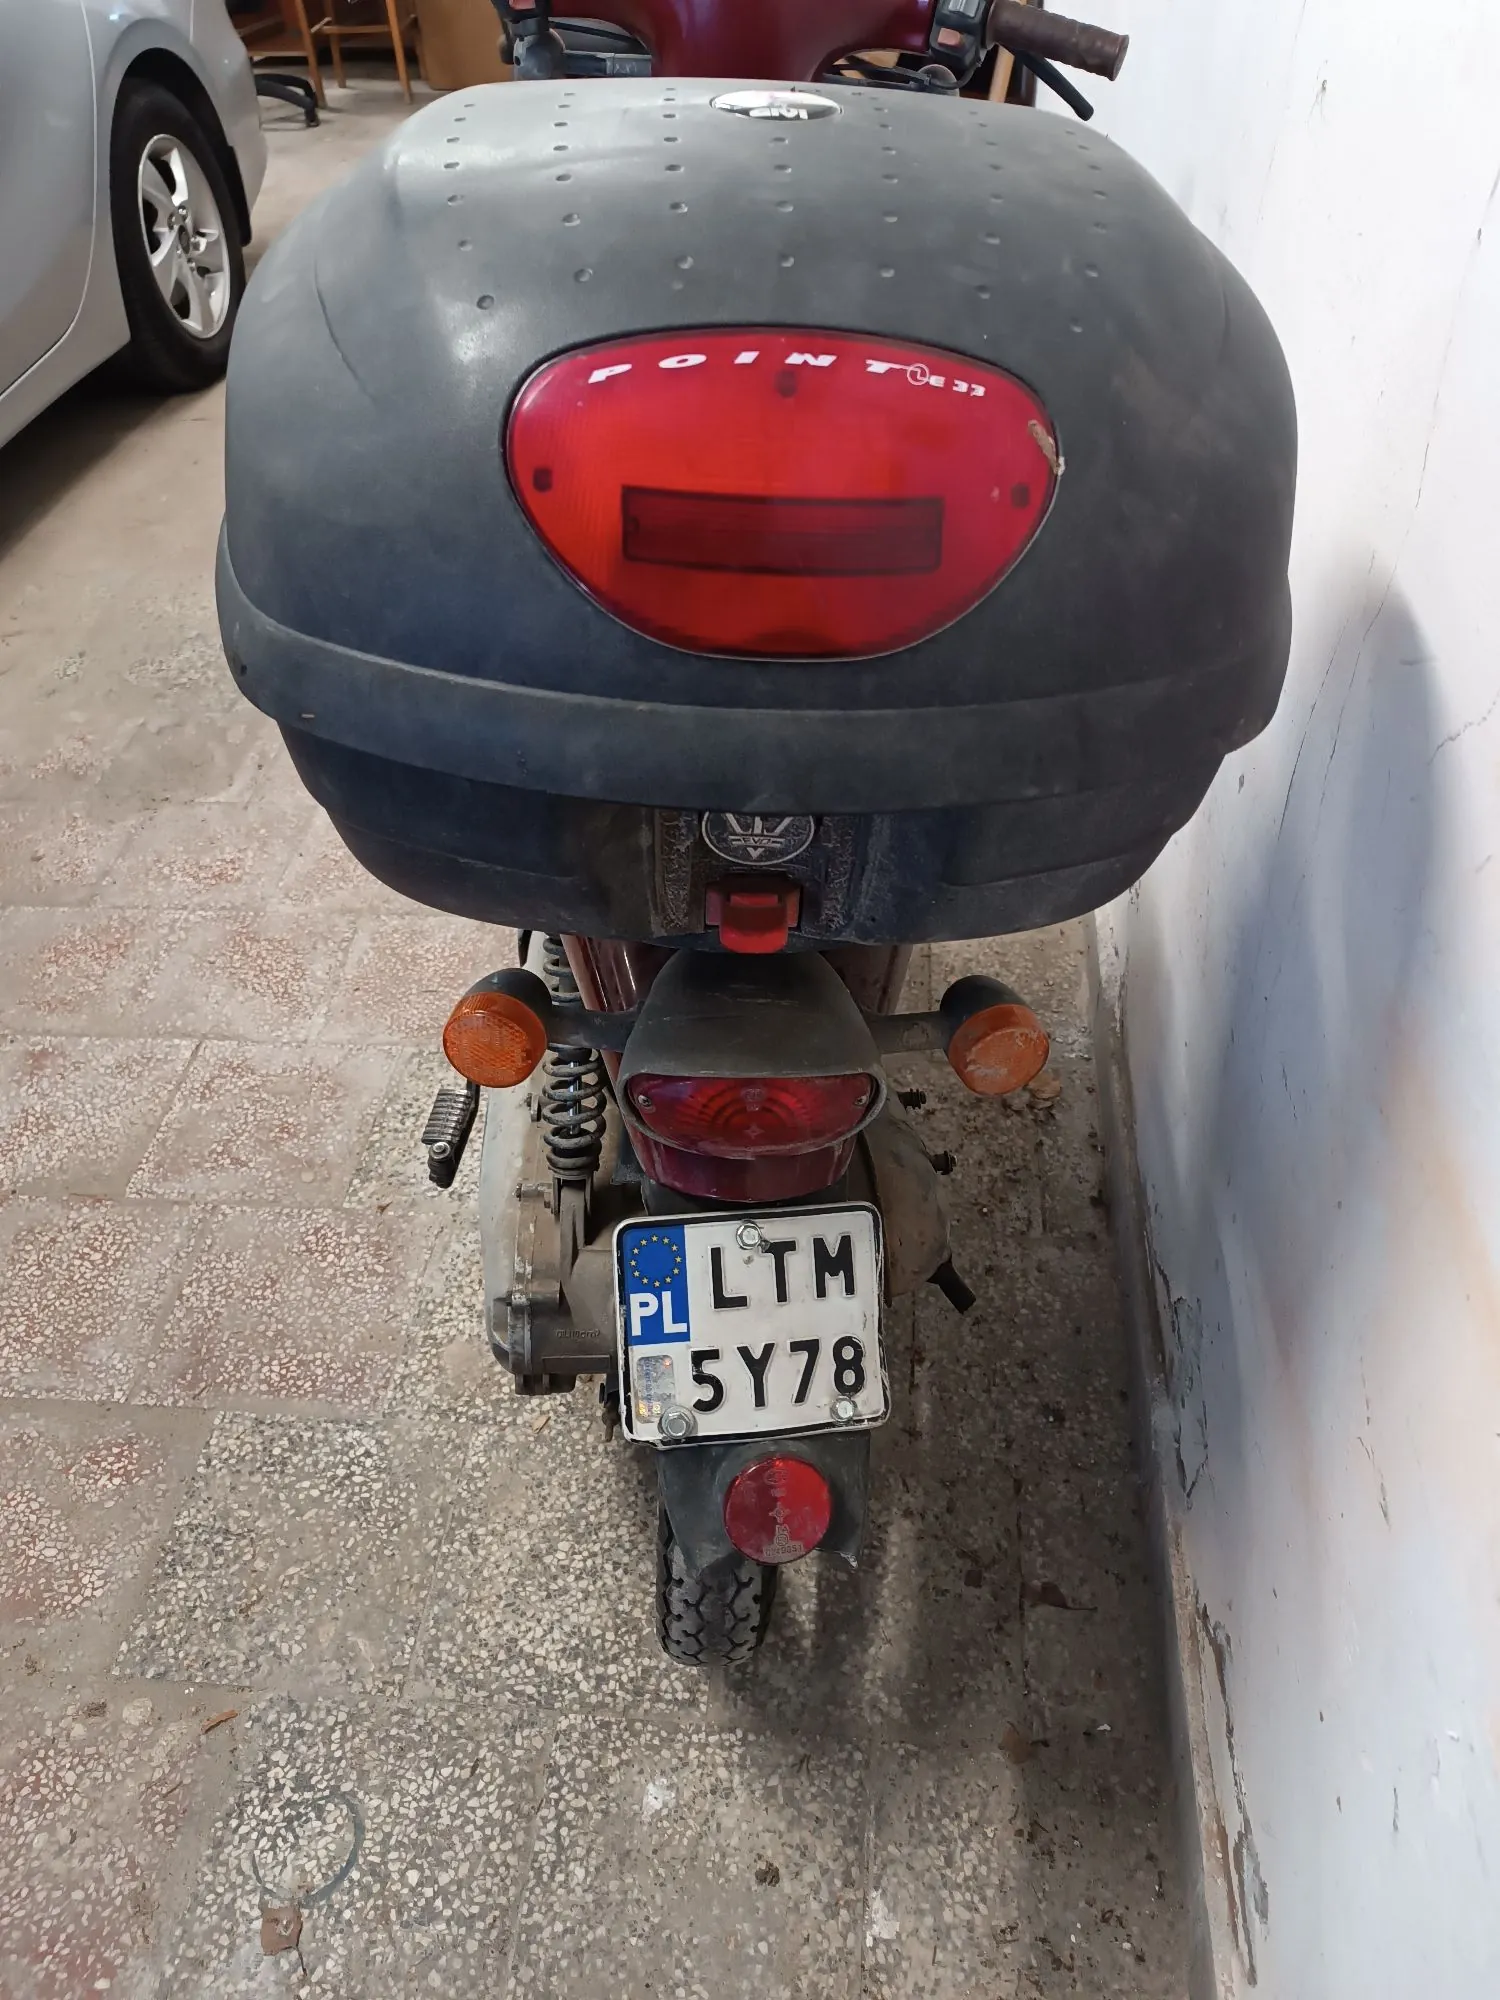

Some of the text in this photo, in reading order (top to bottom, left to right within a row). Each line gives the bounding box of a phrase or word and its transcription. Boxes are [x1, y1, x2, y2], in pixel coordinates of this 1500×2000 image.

[587, 350, 898, 384] POINT
[709, 1233, 856, 1311] LTM
[629, 1289, 688, 1337] PL
[690, 1335, 867, 1413] 5Y78
